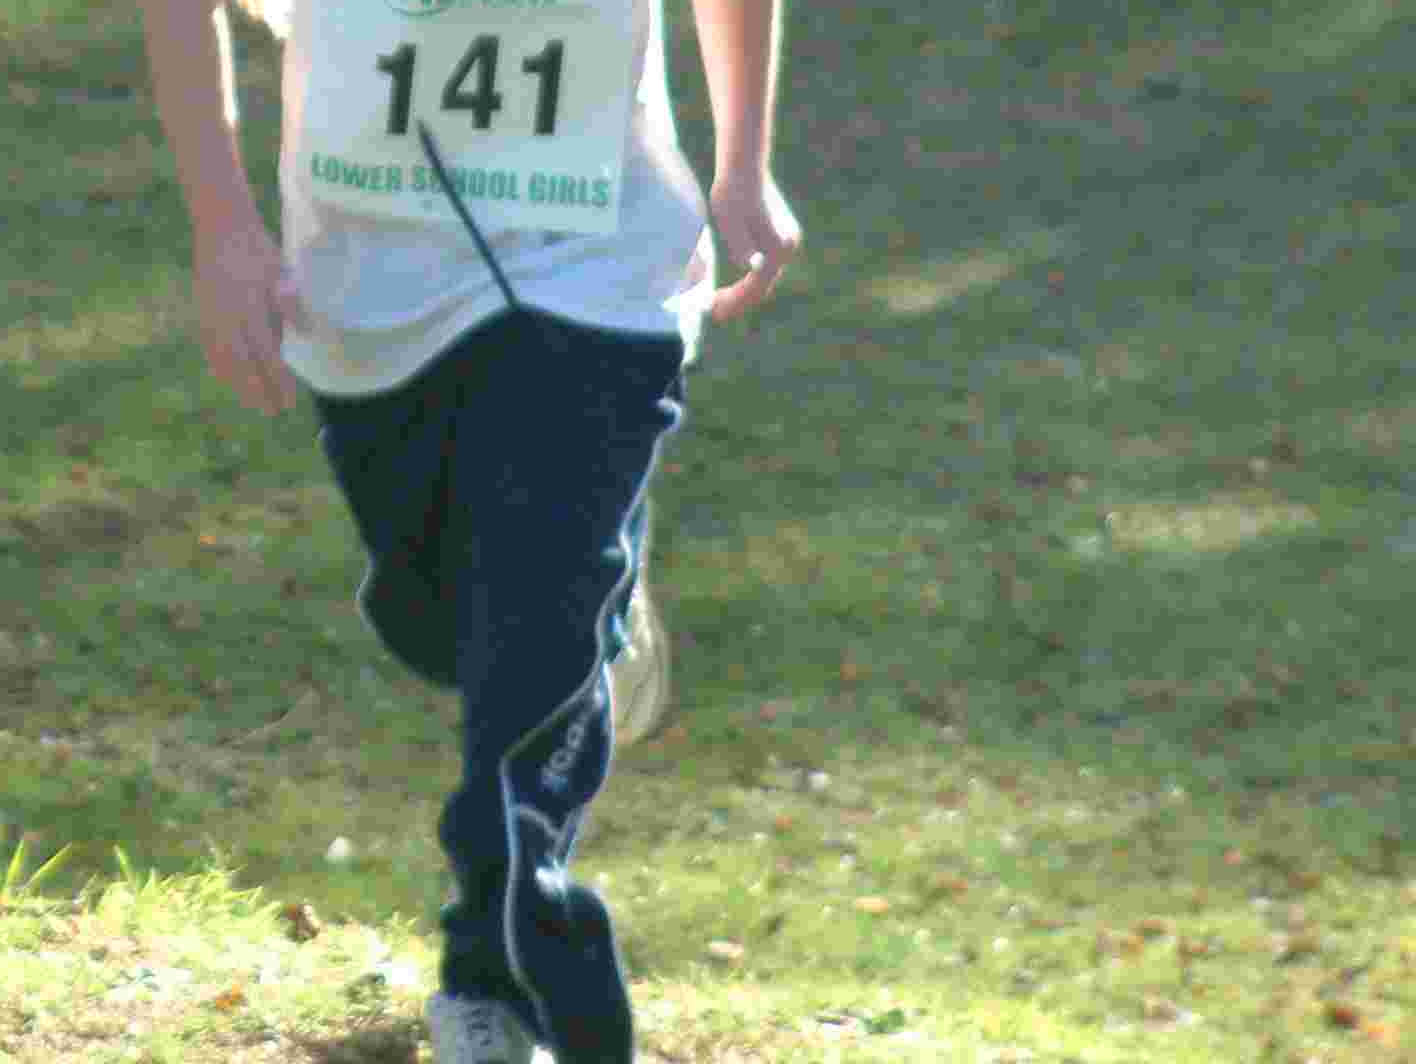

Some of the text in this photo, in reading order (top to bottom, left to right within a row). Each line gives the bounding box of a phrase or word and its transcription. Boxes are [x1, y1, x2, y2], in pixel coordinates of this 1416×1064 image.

[376, 34, 564, 136] 141
[311, 153, 402, 194] LOWER
[528, 170, 609, 208] GIRLS
